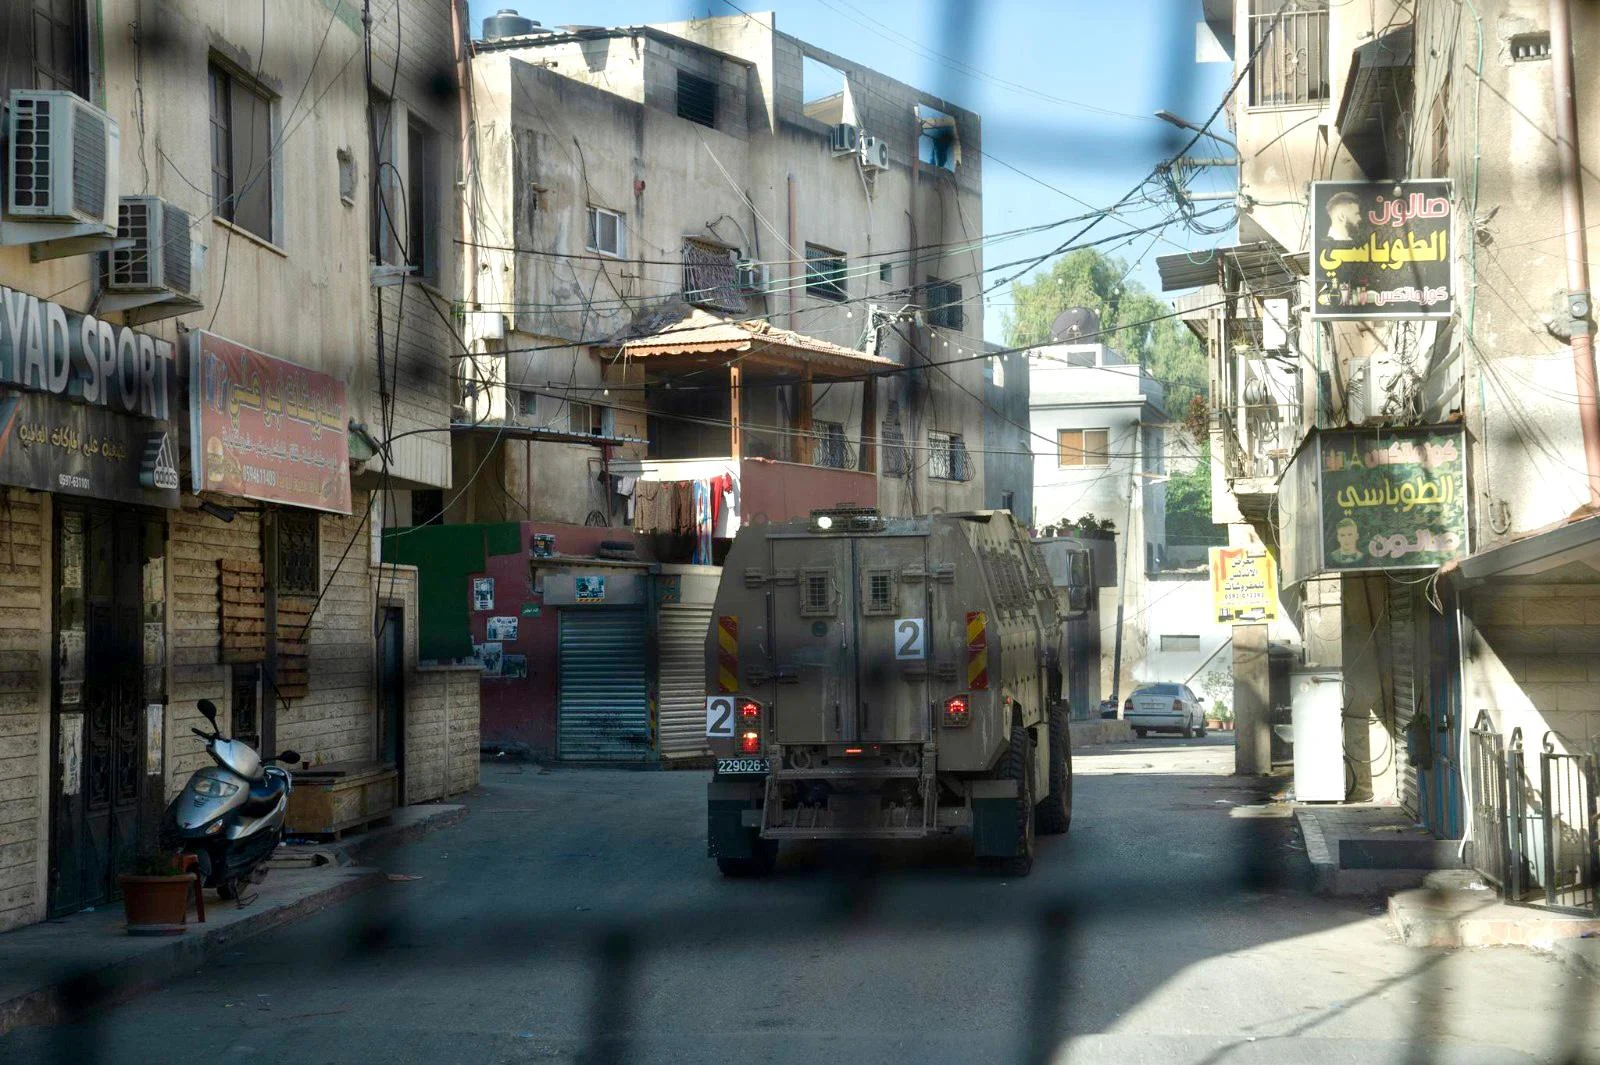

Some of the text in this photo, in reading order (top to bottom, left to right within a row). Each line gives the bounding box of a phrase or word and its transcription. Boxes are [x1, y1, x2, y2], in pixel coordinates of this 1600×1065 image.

[1368, 192, 1450, 227] صالون
[1319, 229, 1447, 277] الطوباسي
[0, 286, 70, 394] YAD
[81, 314, 173, 420] SPORT
[1337, 474, 1454, 515] الطوباسي
[1368, 529, 1460, 559] صالون
[898, 620, 920, 656] 2
[708, 698, 733, 734] 2
